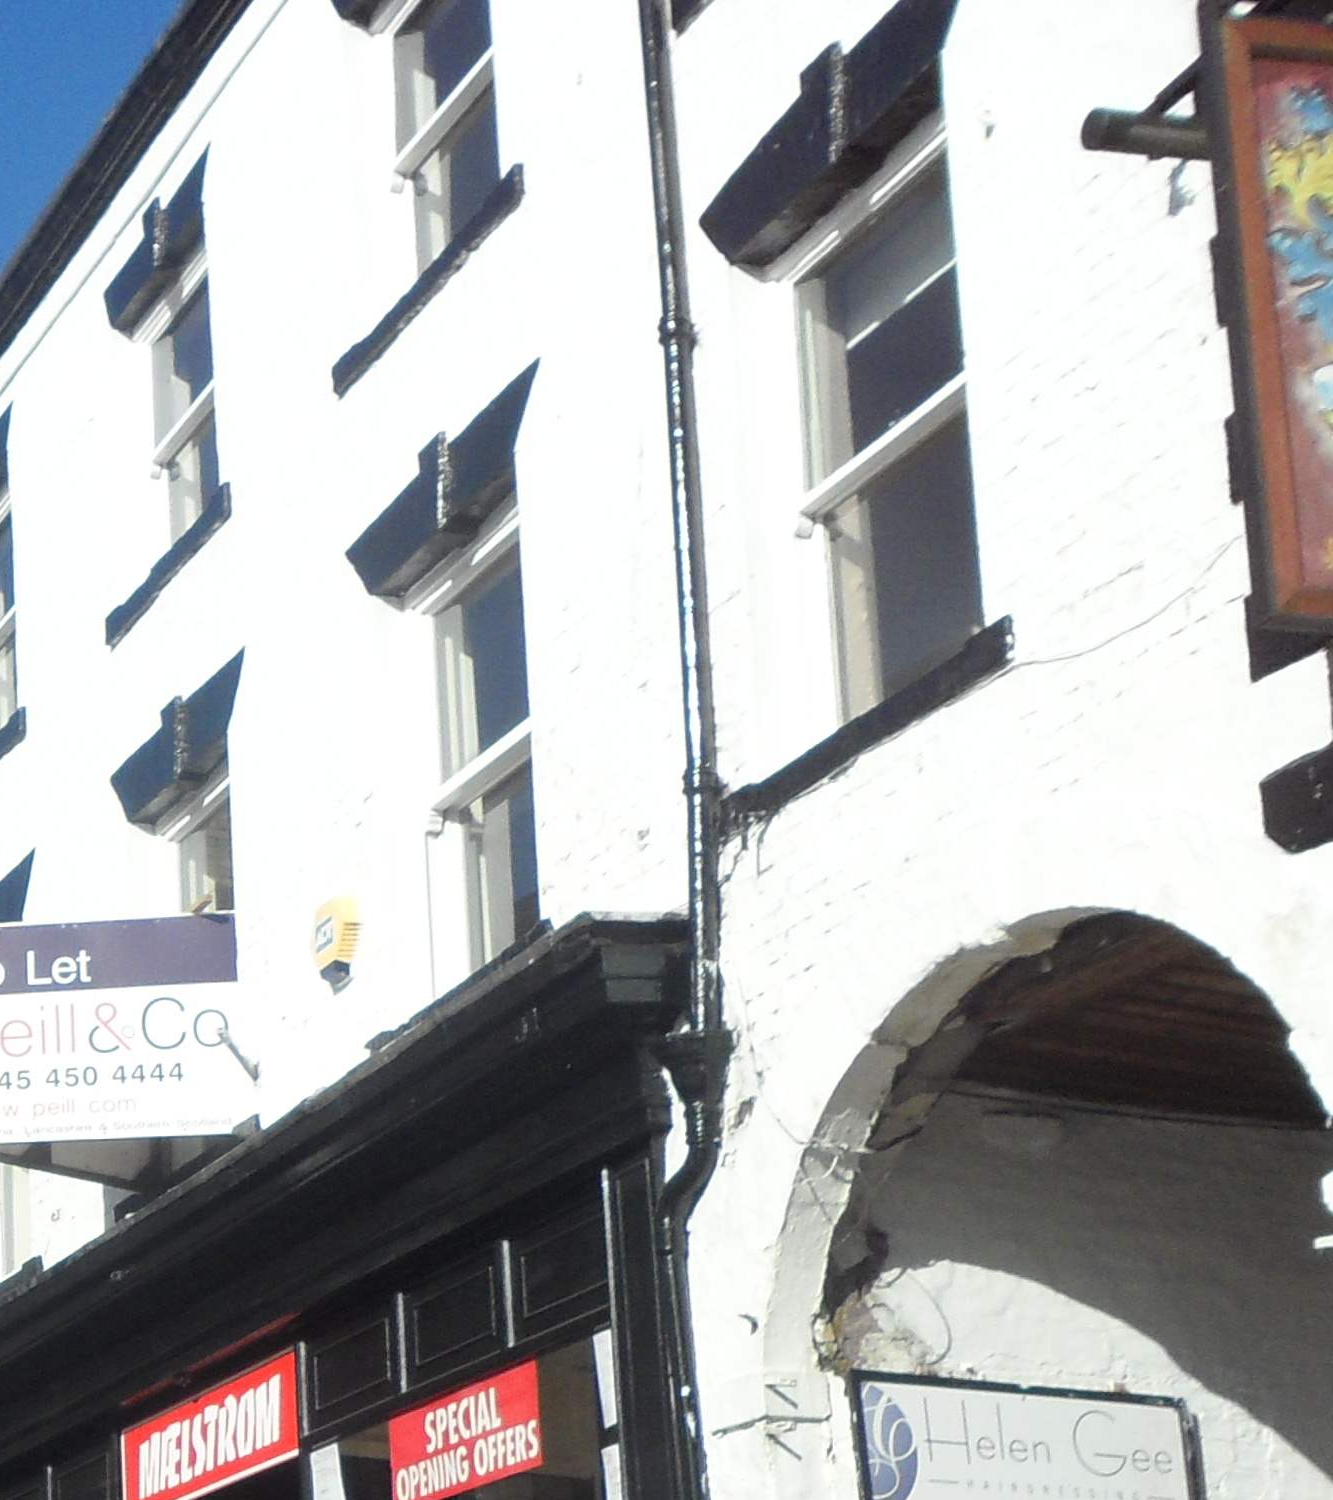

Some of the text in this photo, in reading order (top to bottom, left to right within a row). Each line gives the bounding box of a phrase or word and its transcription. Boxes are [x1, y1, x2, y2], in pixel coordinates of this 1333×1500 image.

[25, 949, 92, 985] Let
[46, 1066, 99, 1088] 450
[112, 1062, 184, 1084] 4444
[424, 1386, 502, 1454] SPECIAL
[472, 1419, 540, 1477] OFFERS
[923, 1397, 1174, 1478] Helen Gee
